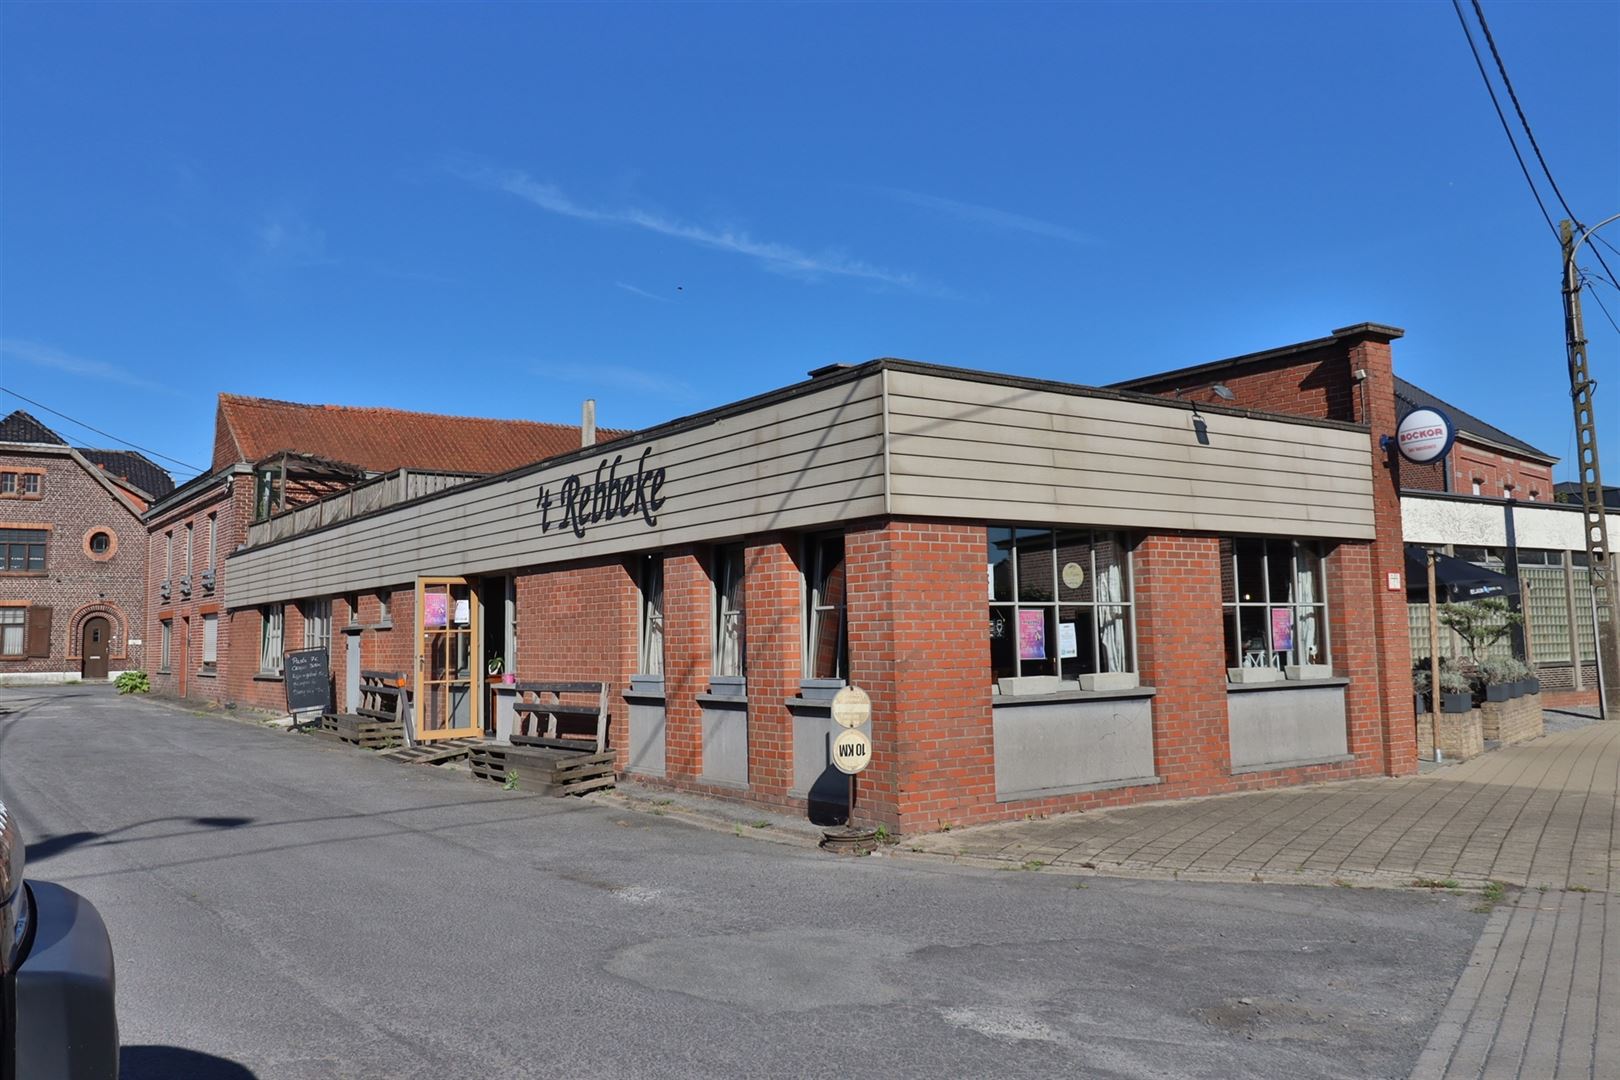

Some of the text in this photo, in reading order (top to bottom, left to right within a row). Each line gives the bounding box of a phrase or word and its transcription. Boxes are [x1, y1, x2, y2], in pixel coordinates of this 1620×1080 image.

[1400, 428, 1443, 442] BOCKOR
[559, 447, 666, 539] Rebbeke
[839, 743, 866, 757] 10 KM
